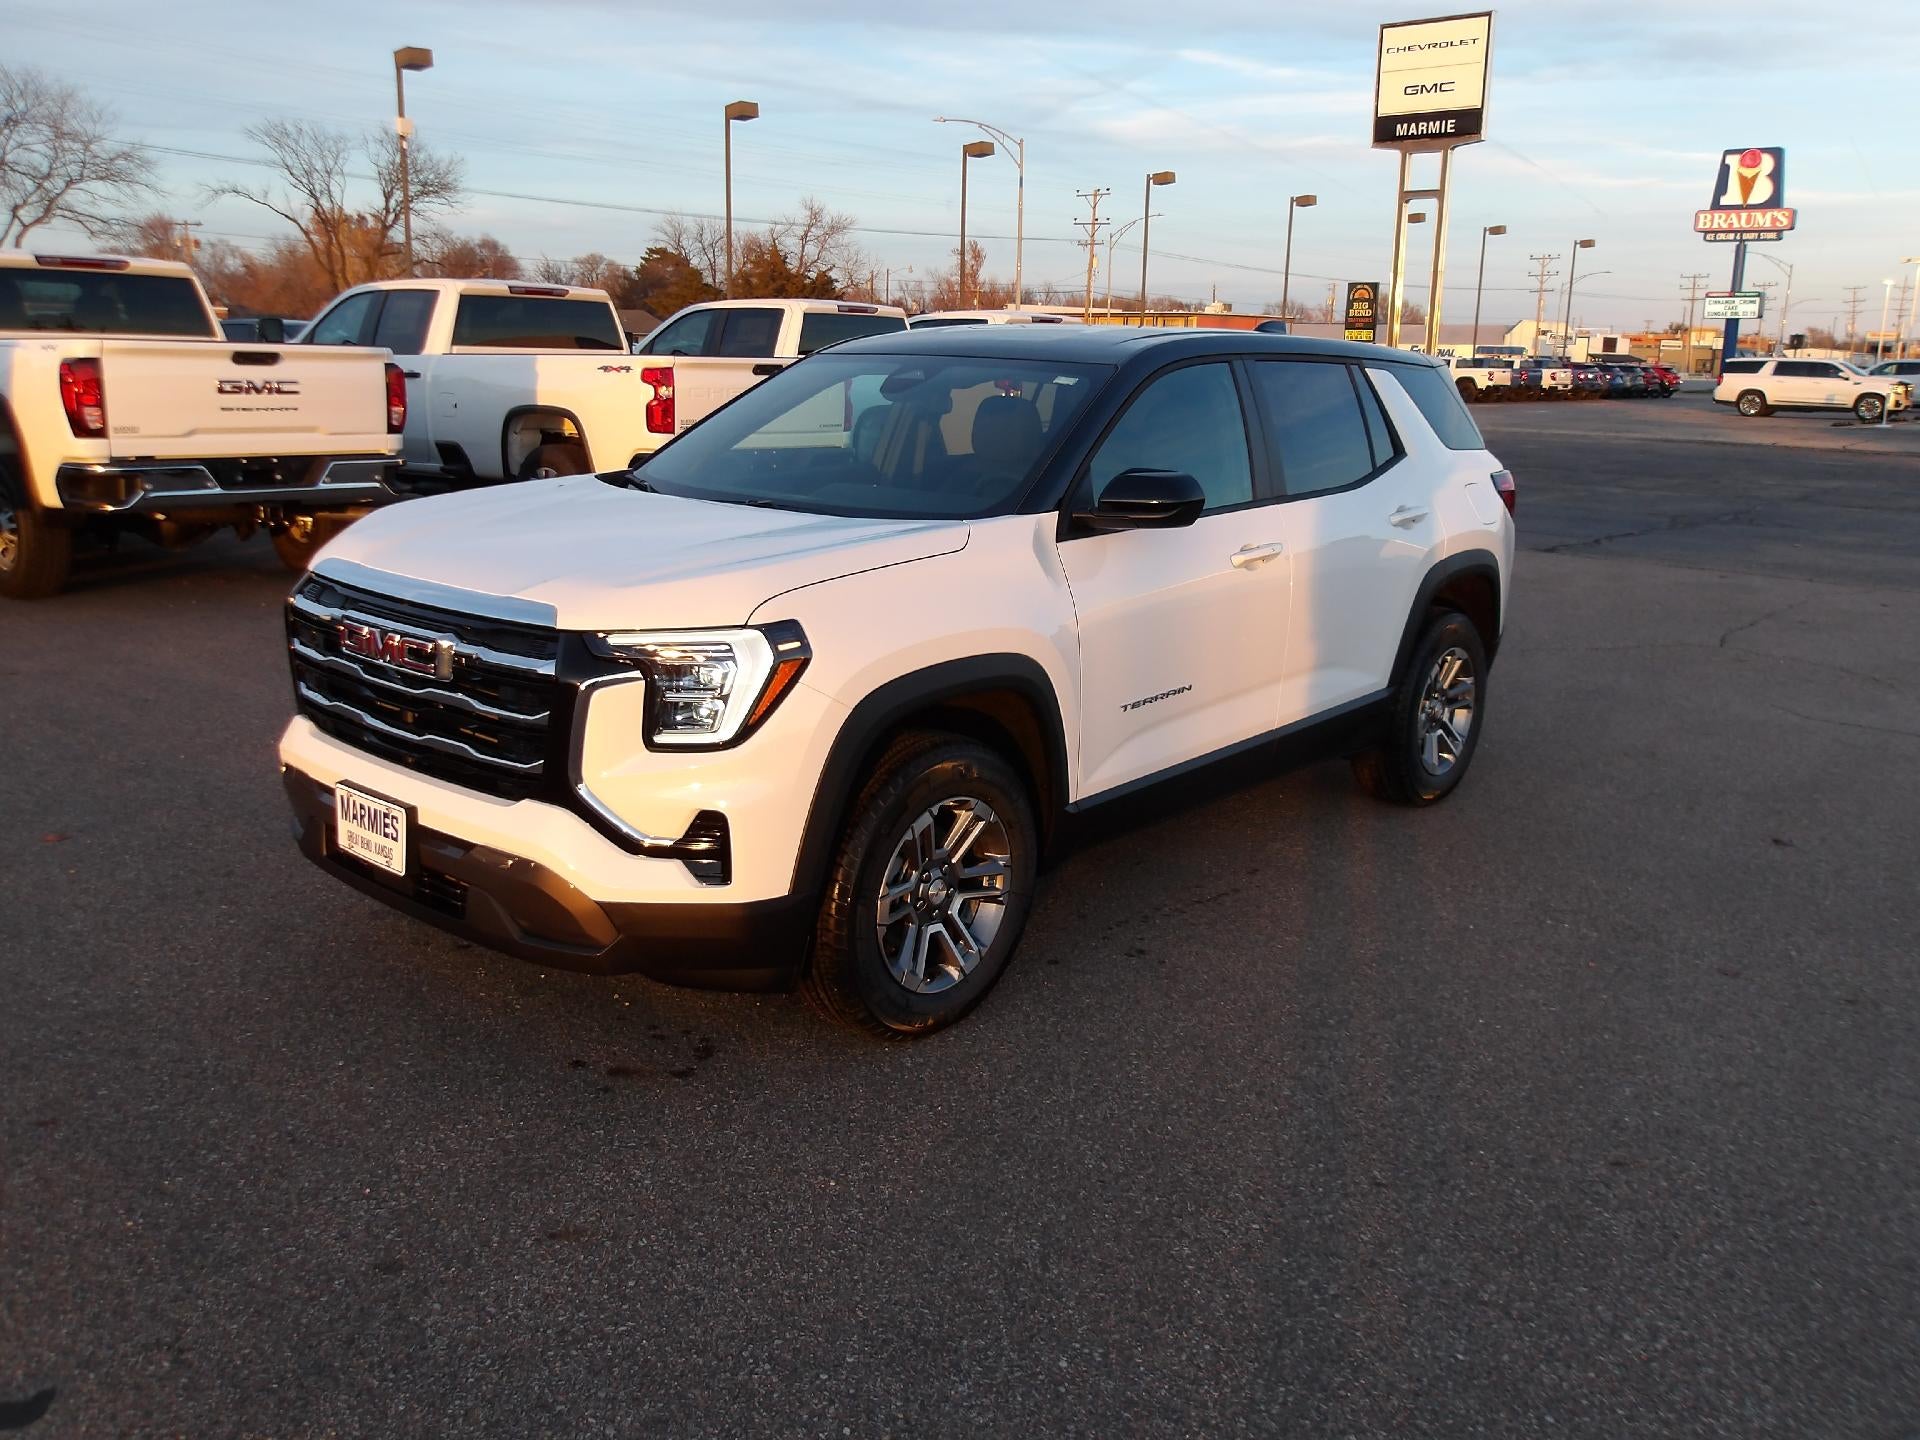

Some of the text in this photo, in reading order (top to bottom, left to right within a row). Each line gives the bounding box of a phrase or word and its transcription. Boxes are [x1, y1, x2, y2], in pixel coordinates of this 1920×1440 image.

[1386, 37, 1480, 54] CHEVROLET
[1404, 81, 1456, 96] GMC
[1396, 119, 1456, 137] MARMIE
[1697, 210, 1789, 230] BRAUM'S
[1348, 309, 1372, 317] BEND
[1353, 302, 1369, 310] BIG
[217, 380, 300, 394] GMC
[337, 617, 440, 678] GMC
[1120, 684, 1192, 712] TERRAIN
[340, 795, 399, 843] MARMIES
